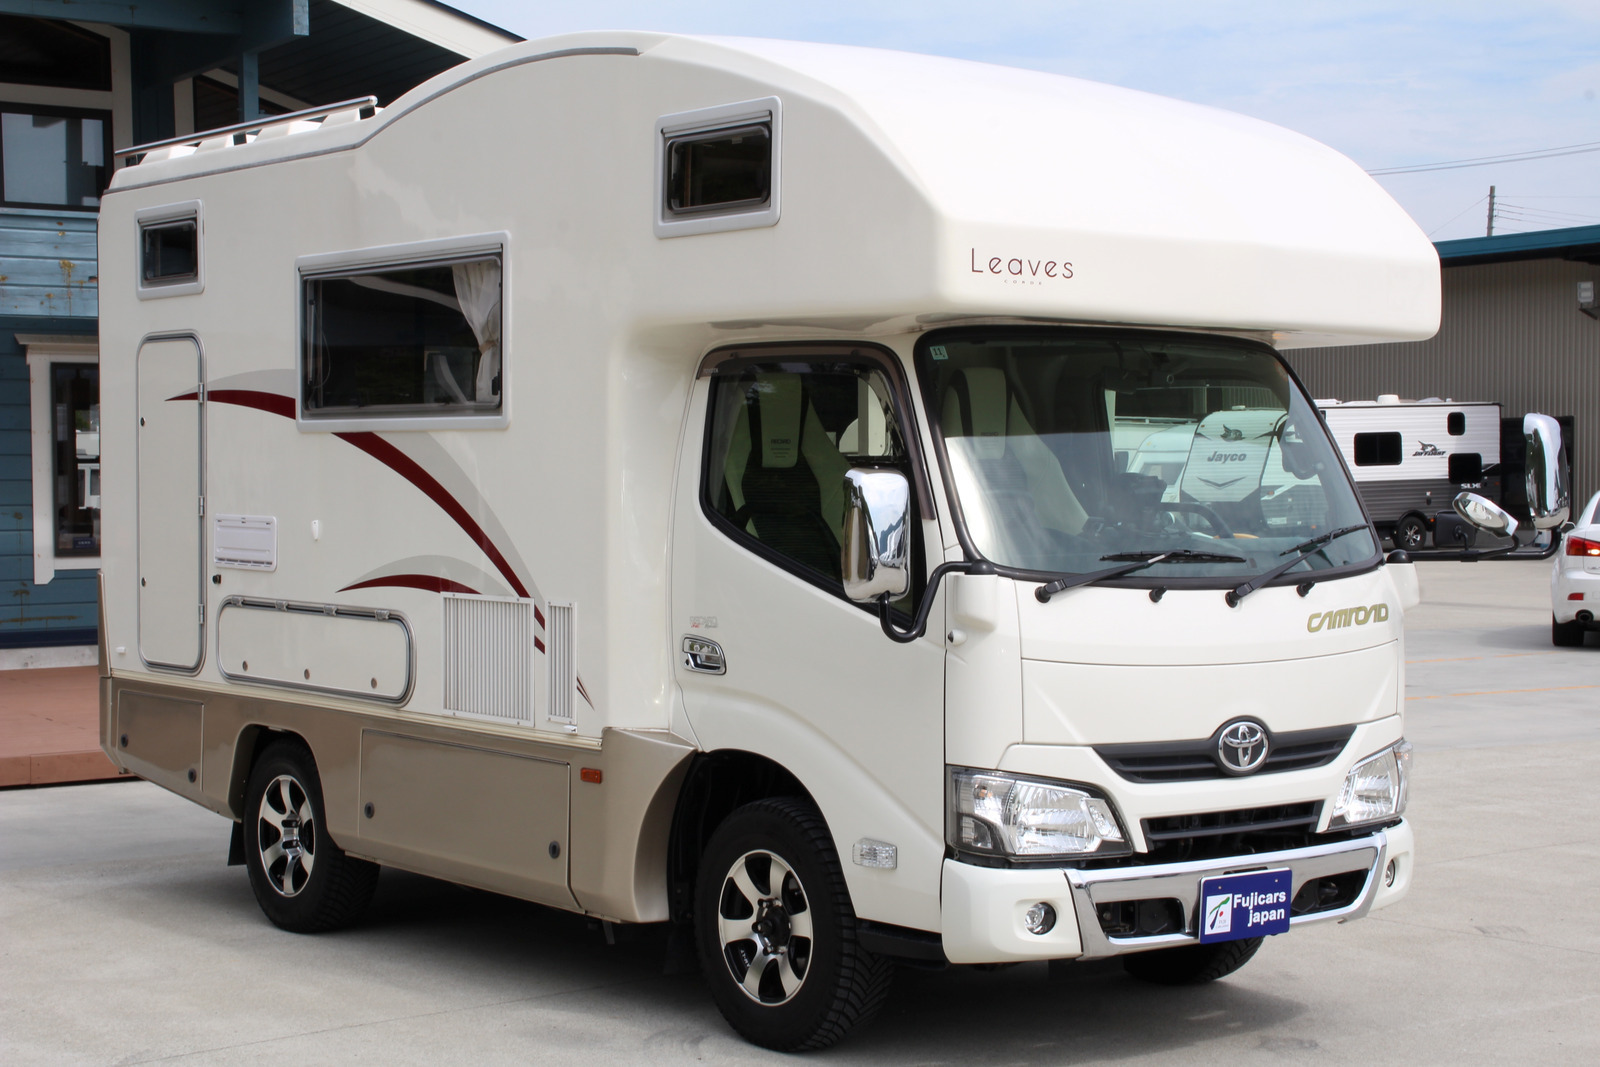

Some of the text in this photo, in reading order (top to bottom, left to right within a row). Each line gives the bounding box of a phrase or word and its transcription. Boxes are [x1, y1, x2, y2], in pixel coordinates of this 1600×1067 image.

[971, 247, 1074, 279] Leaves
[1207, 450, 1247, 464] Jayco
[1233, 891, 1286, 910] Fujicars
[1247, 908, 1285, 927] japan
